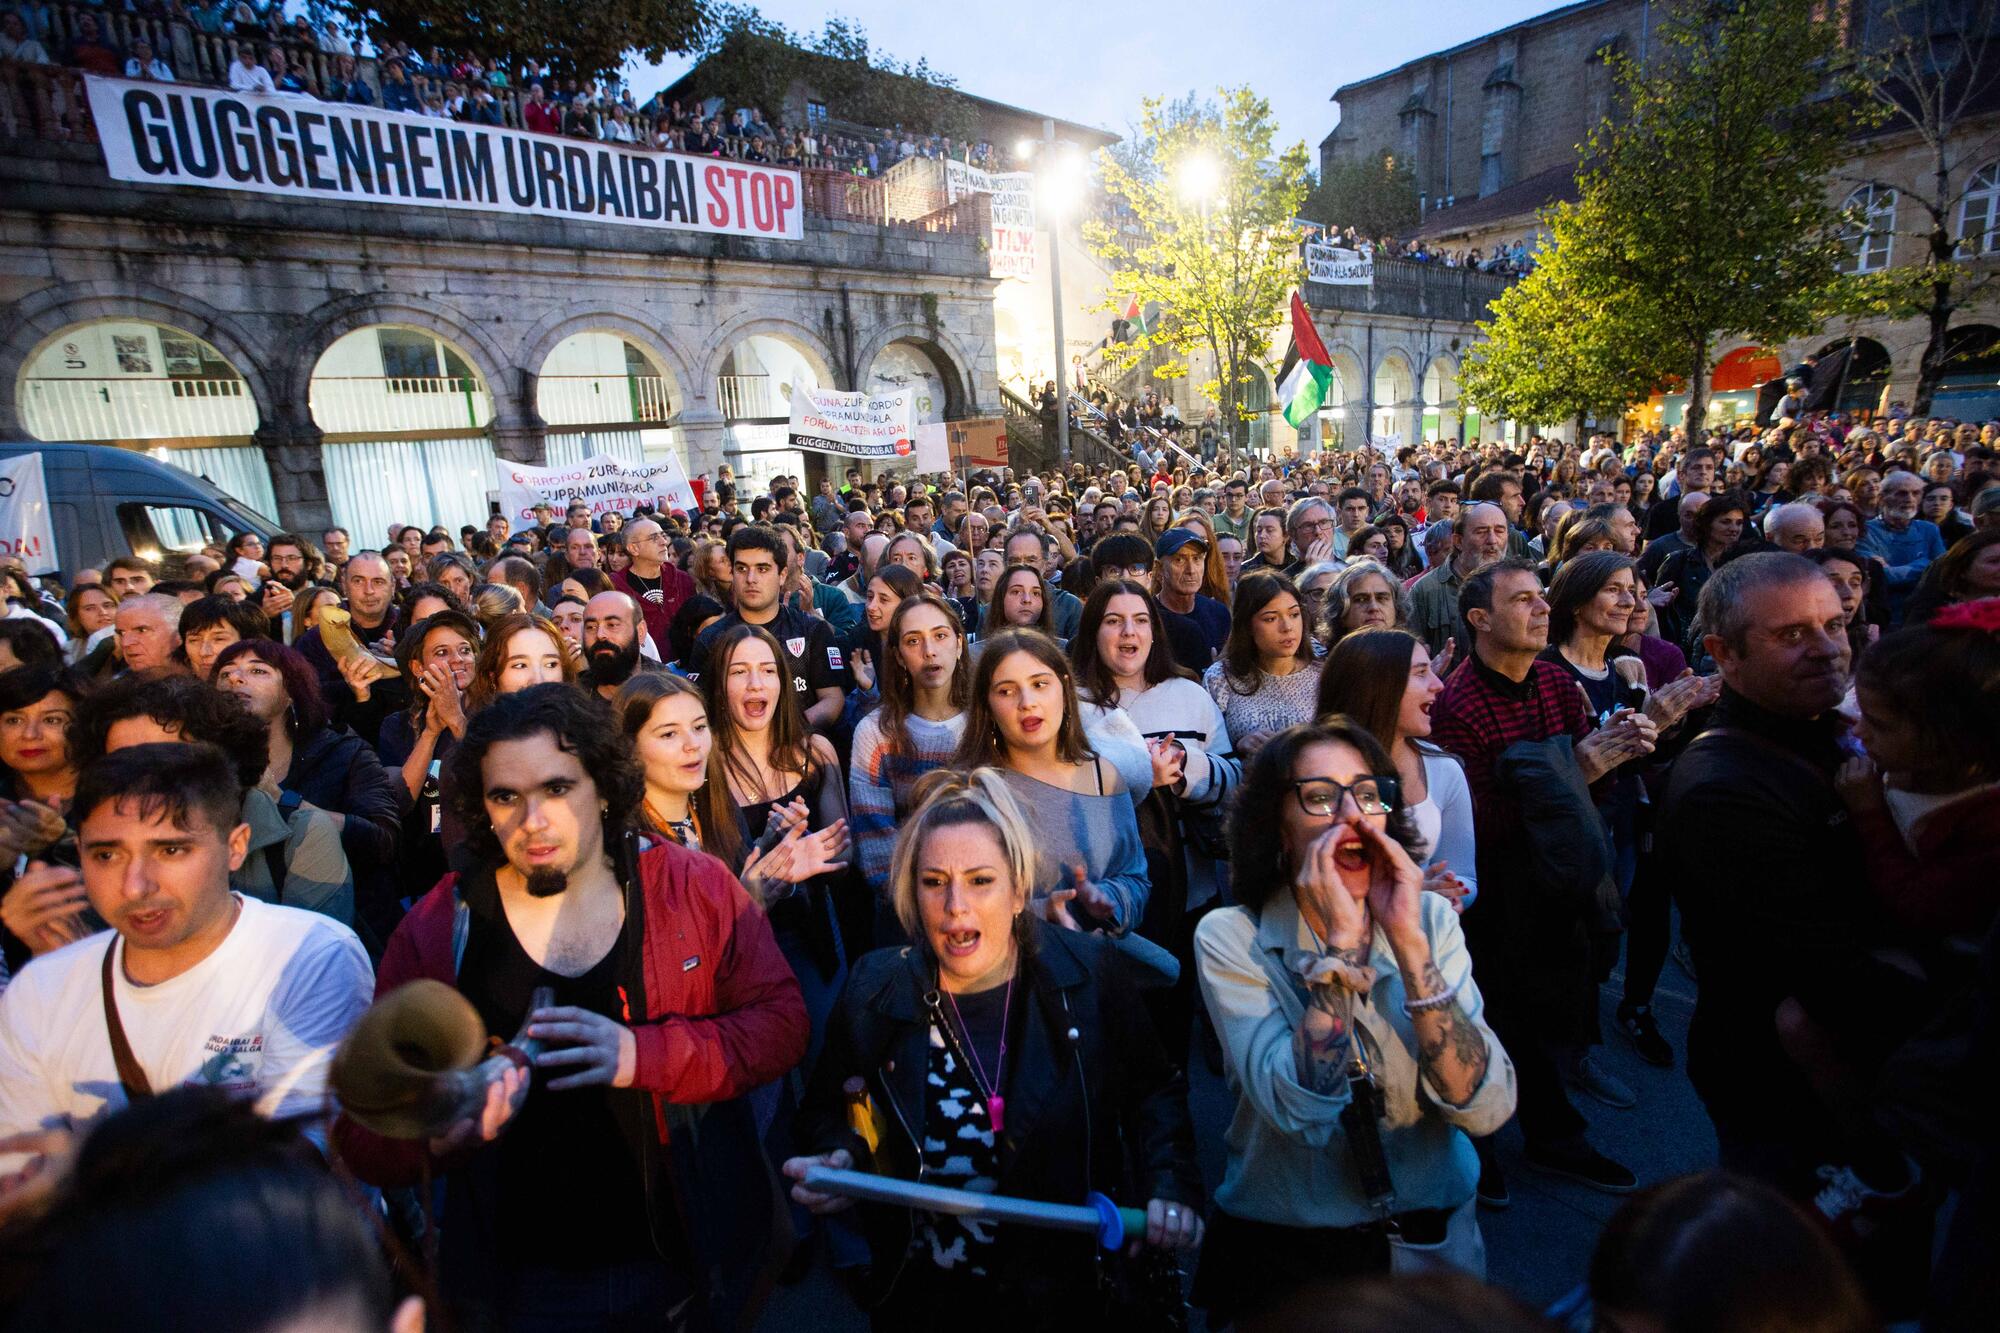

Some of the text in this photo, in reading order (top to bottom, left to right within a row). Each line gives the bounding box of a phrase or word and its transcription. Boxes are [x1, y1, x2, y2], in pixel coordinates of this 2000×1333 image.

[122, 89, 795, 233] GUGGENHEIM URDAIBAI STOP
[888, 423, 906, 436] DA!
[796, 436, 857, 454] GUGGENHEIM
[587, 464, 619, 478] ZURE
